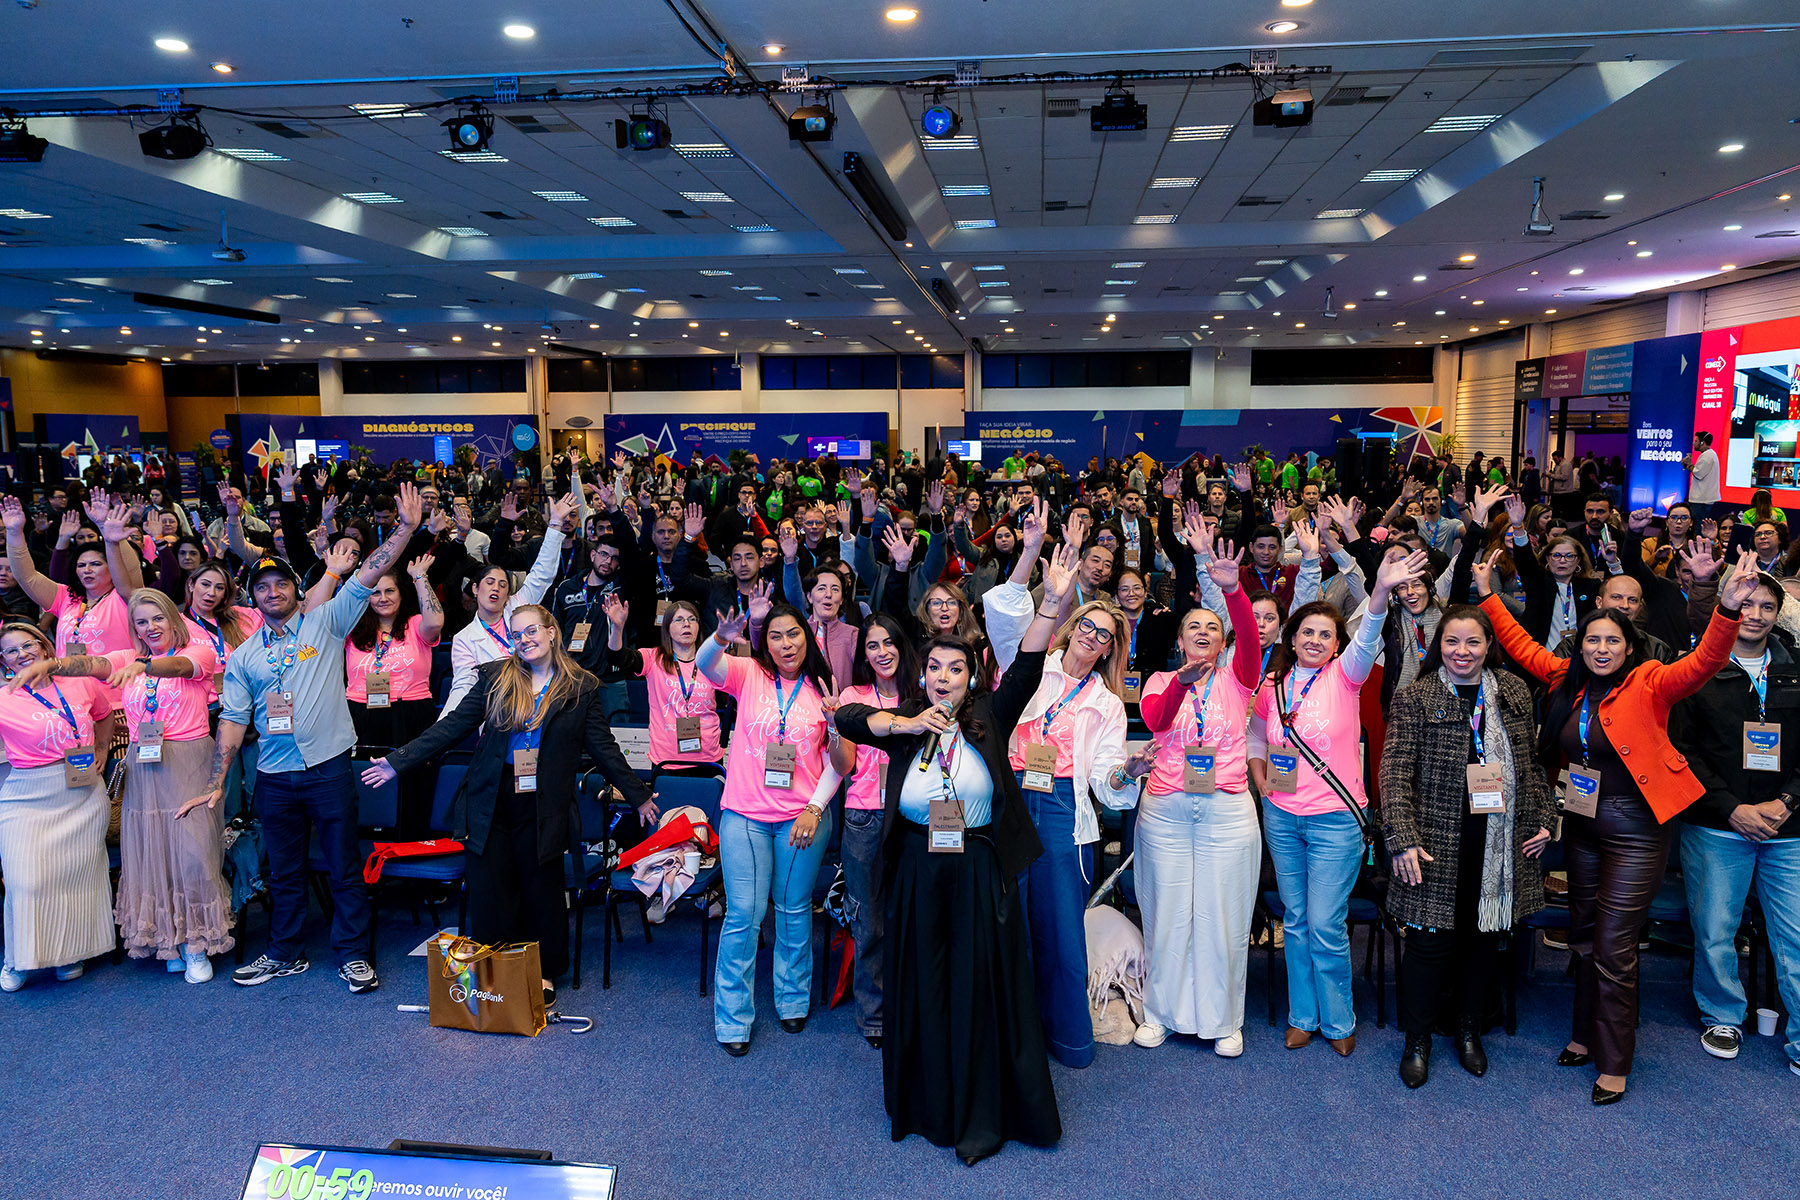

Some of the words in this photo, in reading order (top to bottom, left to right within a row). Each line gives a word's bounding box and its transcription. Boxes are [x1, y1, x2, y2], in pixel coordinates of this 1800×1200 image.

[1757, 394, 1780, 414] Méqui
[363, 421, 474, 432] DIAGNÓSTICOS
[980, 426, 1053, 438] NEGÓCIO
[1636, 429, 1673, 440] VENTOS
[1646, 440, 1658, 449] para
[1762, 444, 1778, 455] Méqui
[1640, 448, 1682, 462] NEGÓCIO
[470, 988, 504, 1003] PagBank
[267, 1164, 374, 1200] 00:59
[425, 1182, 464, 1199] ouvir
[466, 1186, 508, 1200] você!
